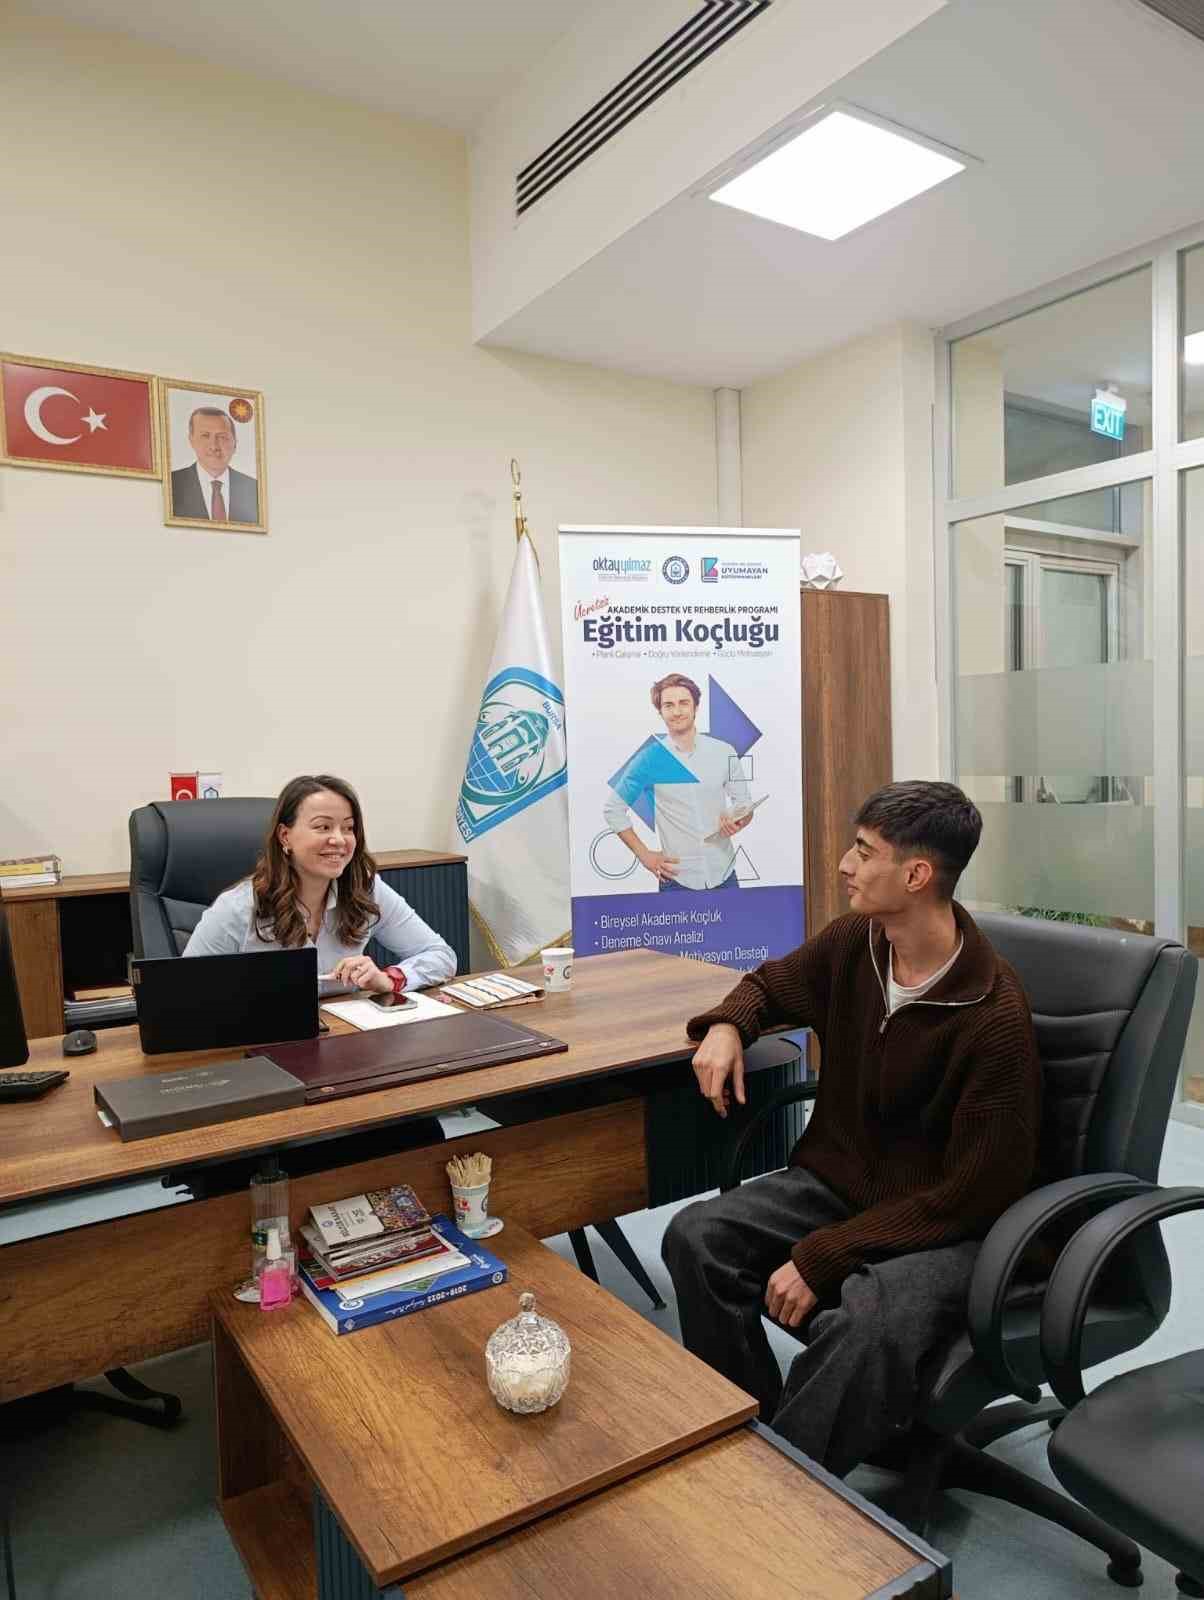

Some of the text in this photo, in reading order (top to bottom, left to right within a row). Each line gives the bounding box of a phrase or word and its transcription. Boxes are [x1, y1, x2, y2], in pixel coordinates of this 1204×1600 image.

[1095, 404, 1124, 436] EXIT
[607, 604, 779, 614] AKADEMİK DESTEK VE REHBERLİK PROGRAMI
[583, 615, 779, 650] Eğitim Koçluğu
[601, 908, 722, 931] Bireysel Akademik Koçluk
[601, 929, 704, 949] Deneme Sınavı Analizi
[680, 945, 769, 964] Motivasyon Desteği
